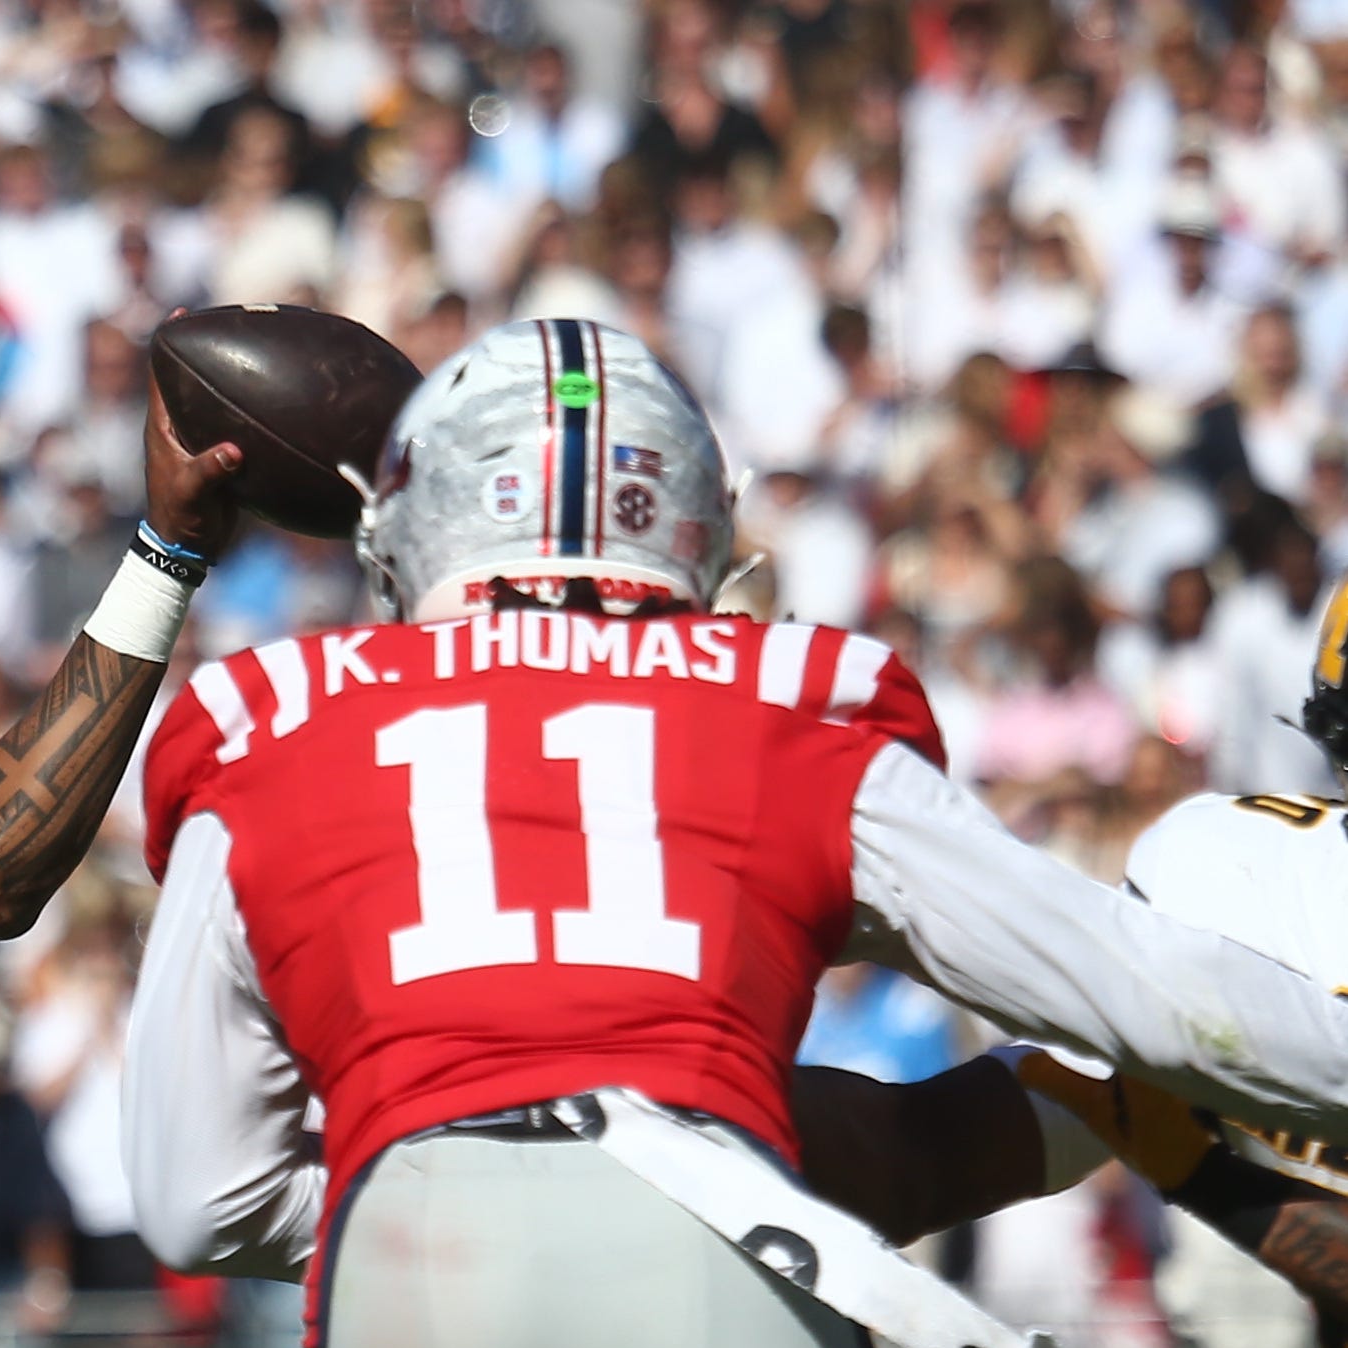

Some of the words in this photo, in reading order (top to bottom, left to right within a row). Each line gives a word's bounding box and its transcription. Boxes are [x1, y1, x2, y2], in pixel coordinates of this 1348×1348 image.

[321, 629, 400, 697] K.
[421, 610, 738, 682] THOMAS
[375, 702, 702, 987] 11
